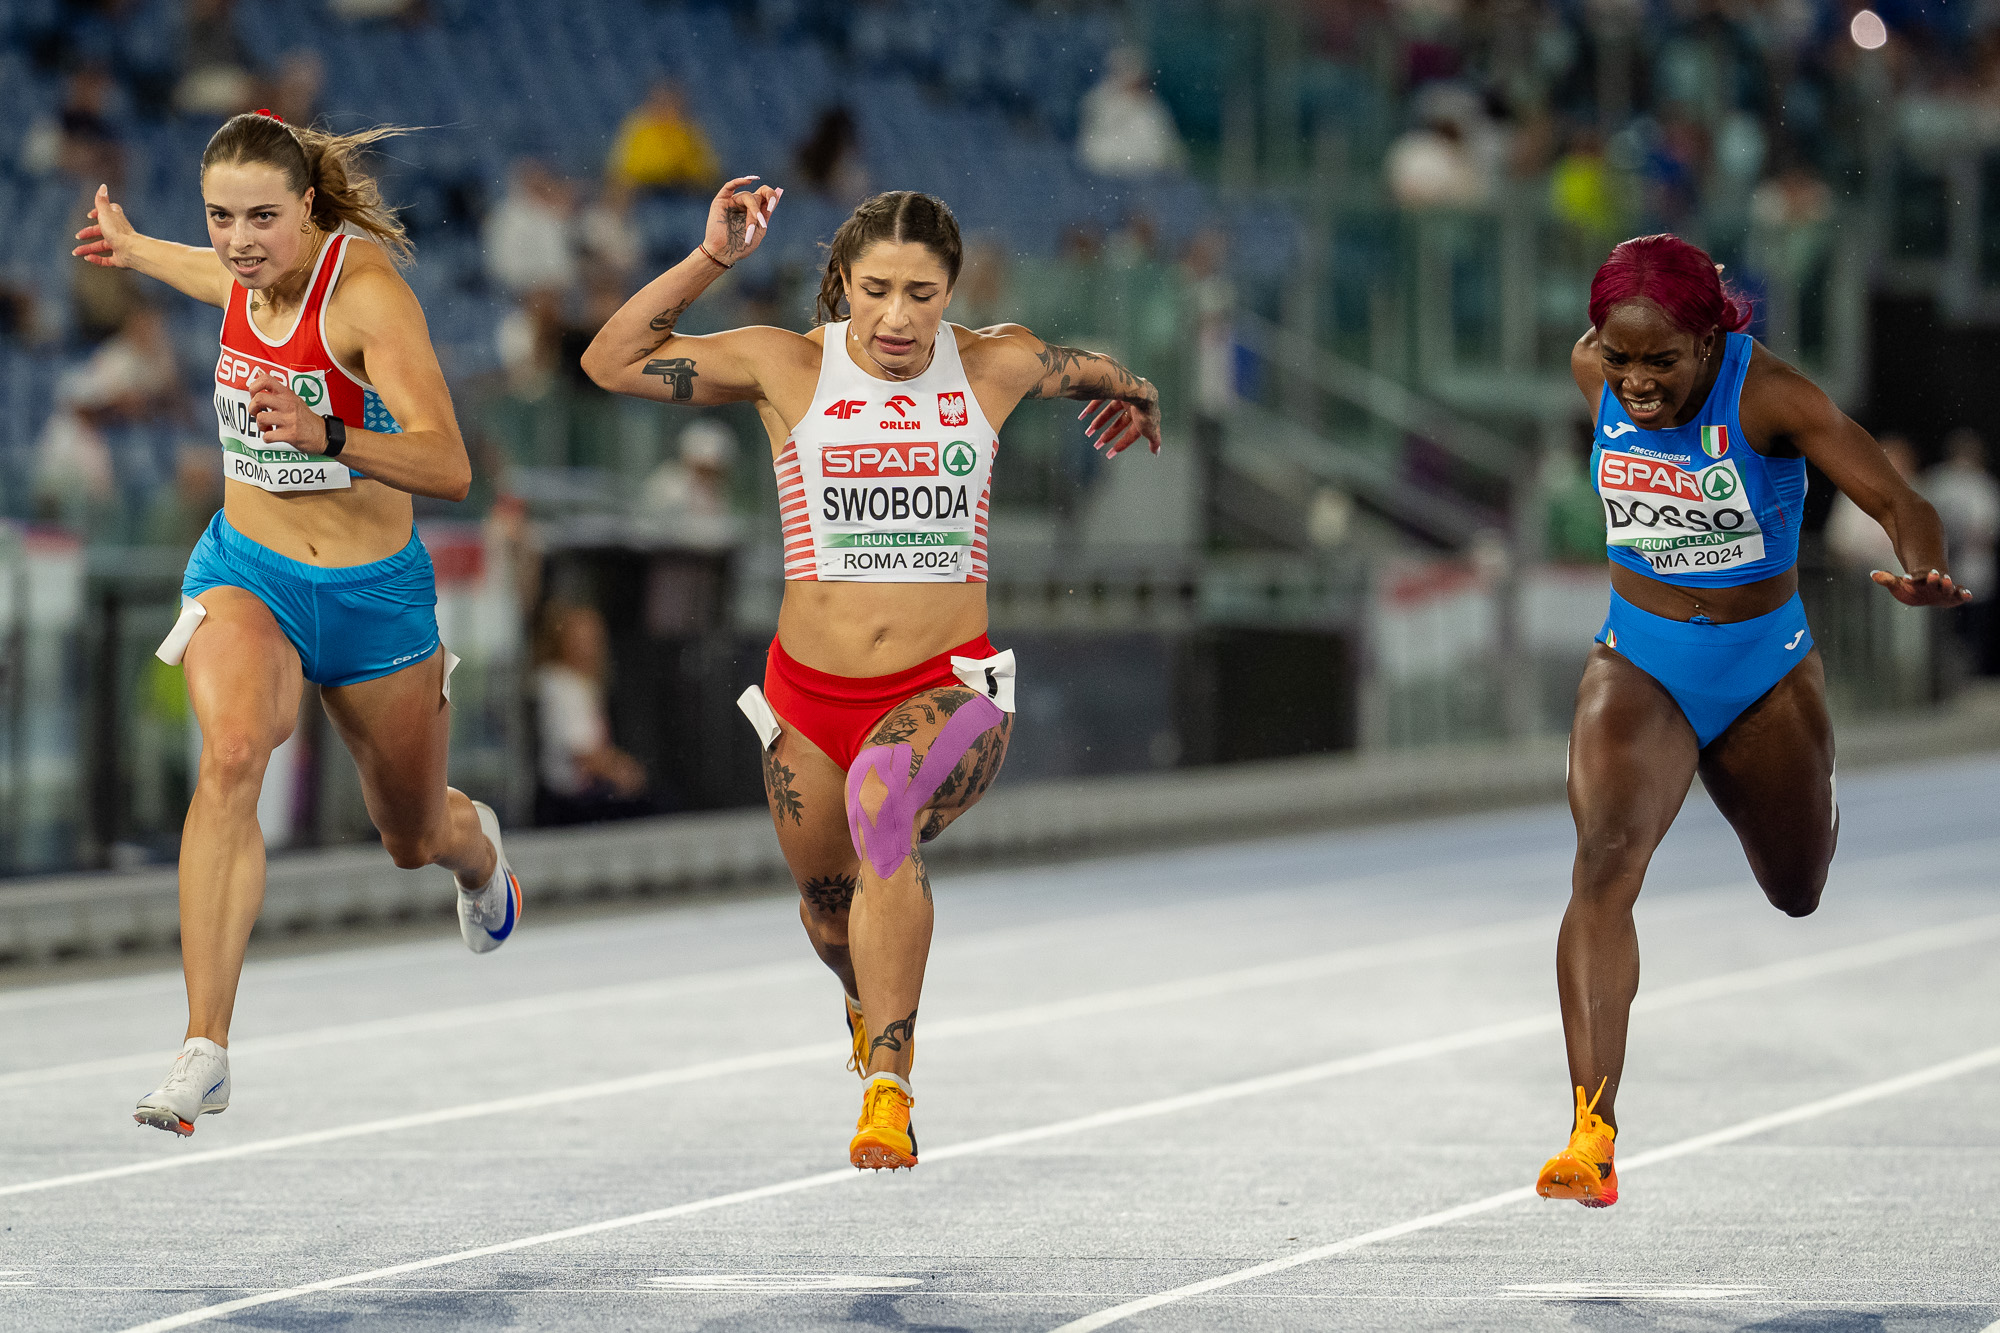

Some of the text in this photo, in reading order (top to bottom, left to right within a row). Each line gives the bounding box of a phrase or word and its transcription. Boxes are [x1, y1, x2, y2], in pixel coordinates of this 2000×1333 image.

[238, 402, 268, 438] DE
[824, 399, 867, 419] 4F
[879, 420, 921, 430] ORLEN
[262, 450, 309, 461] CLEAN
[825, 447, 936, 473] SPAR
[1629, 445, 1691, 462] FRECCIAROSSA
[235, 459, 327, 485] ROMA 2024
[1604, 458, 1700, 497] SPAR
[823, 485, 969, 521] SWOBODA
[1605, 498, 1744, 531] DOSSO
[854, 536, 858, 545] I
[861, 535, 893, 546] RUN
[1641, 538, 1673, 550] RUN
[1676, 532, 1725, 547] CLEAN
[844, 551, 958, 569] ROMA 2024
[1648, 544, 1743, 570] MA 2024
